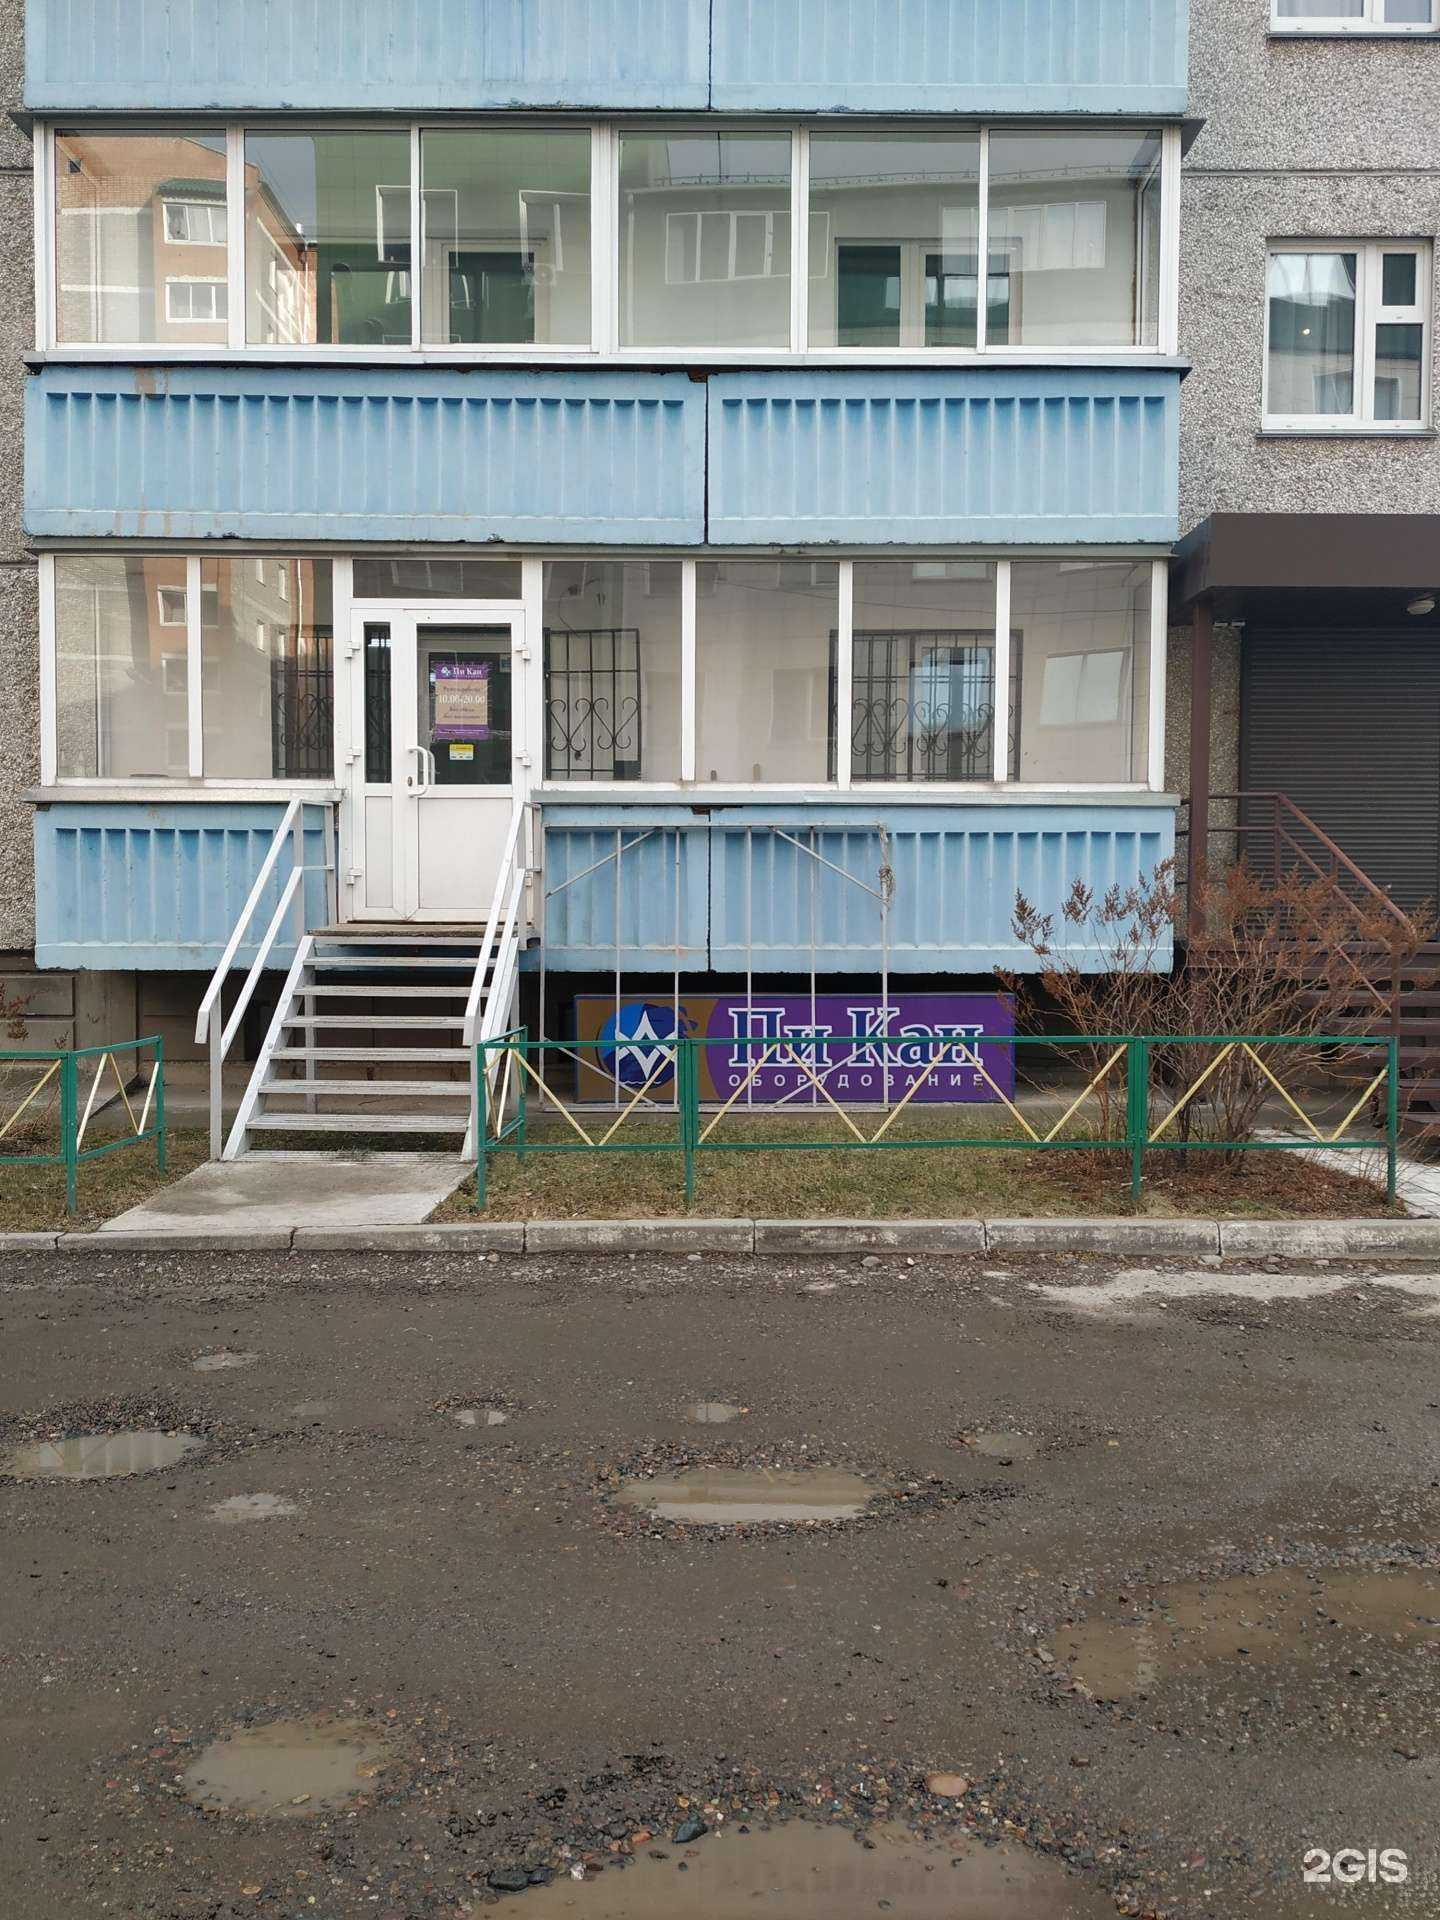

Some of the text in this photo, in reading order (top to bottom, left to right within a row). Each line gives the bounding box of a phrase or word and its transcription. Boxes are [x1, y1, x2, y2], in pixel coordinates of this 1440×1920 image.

[728, 1007, 984, 1068] Пи Кан
[728, 1073, 984, 1088] ОБОРУДОВАНИЕ
